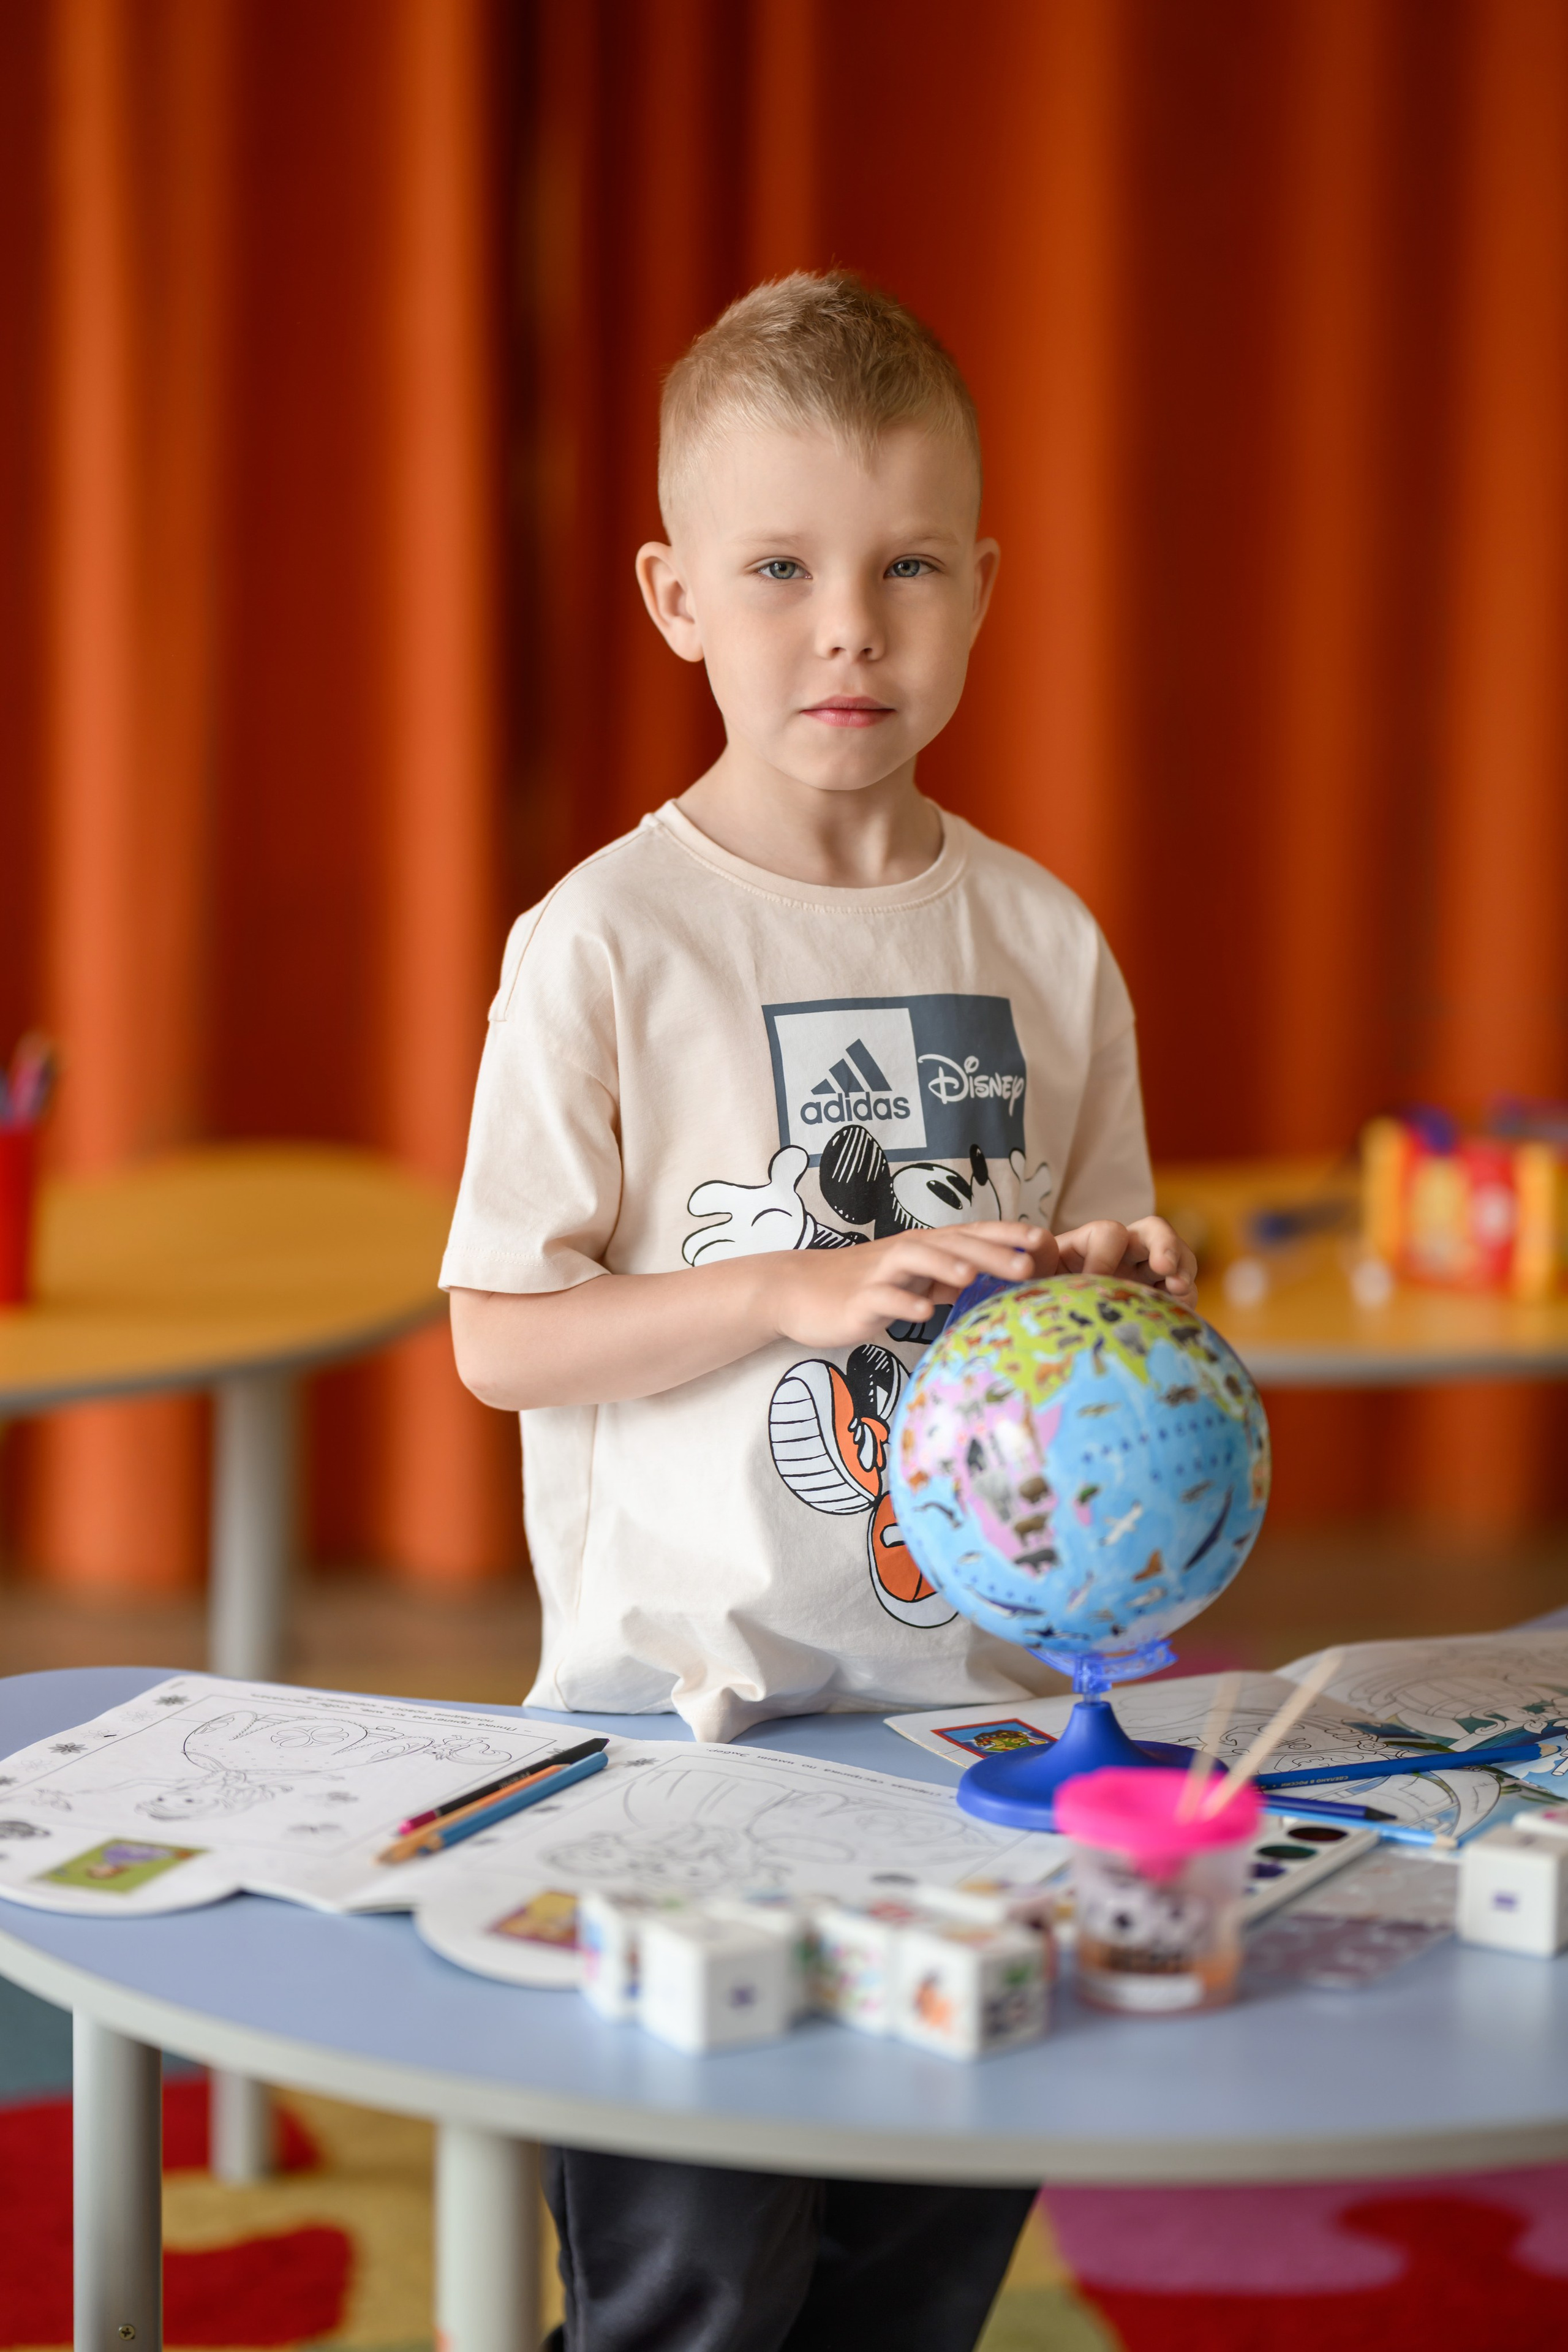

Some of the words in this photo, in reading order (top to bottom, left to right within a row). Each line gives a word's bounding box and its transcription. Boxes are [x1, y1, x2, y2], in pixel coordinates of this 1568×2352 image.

[800, 1091, 911, 1125] adidas
[412, 1716, 470, 1725] прилетела
[434, 1713, 494, 1722] последние
[706, 1749, 750, 1757] Эмбер.
[757, 1755, 794, 1764] имени
